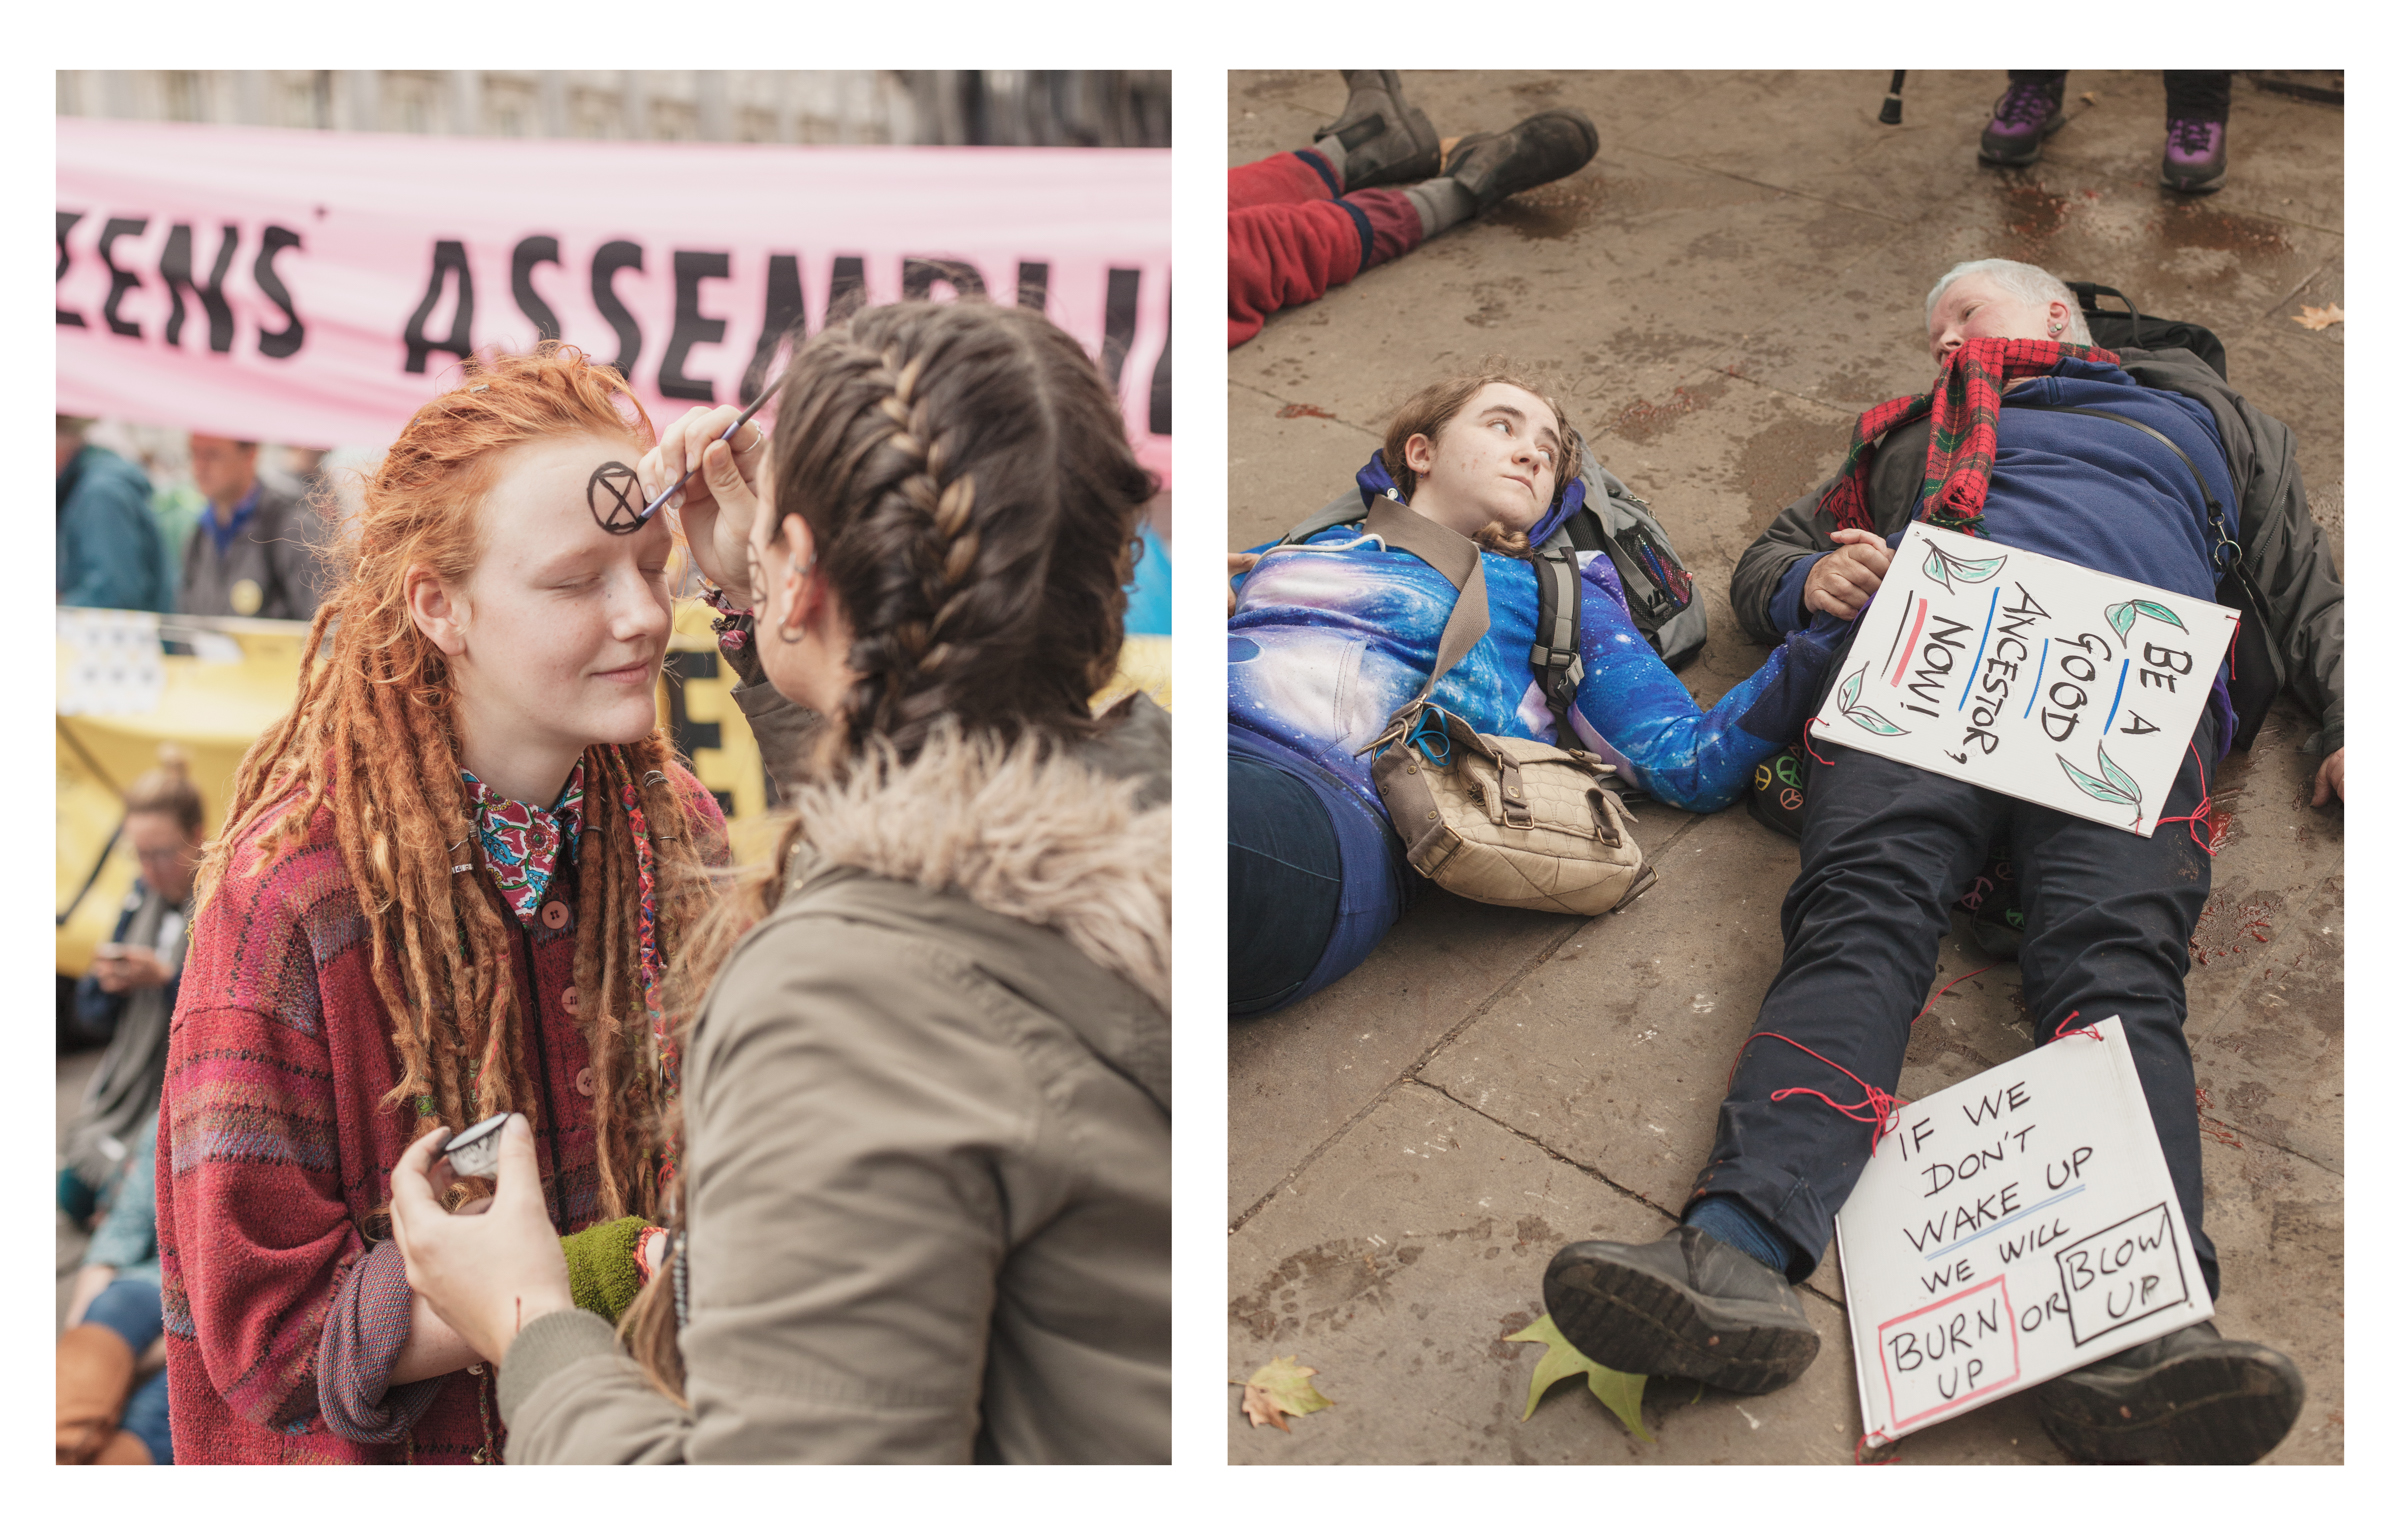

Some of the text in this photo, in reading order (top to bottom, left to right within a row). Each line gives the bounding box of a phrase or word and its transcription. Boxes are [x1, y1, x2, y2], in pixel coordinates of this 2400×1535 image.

[1900, 615, 1974, 720] NOW!
[1943, 581, 2052, 766] ANCESTOR,
[2041, 632, 2112, 743] GOOD
[2120, 641, 2193, 735] BE A
[1898, 1081, 2031, 1161] IF WE
[1921, 1124, 2036, 1198] DON'T
[1903, 1146, 2093, 1253] WAKE UP
[1921, 1218, 2070, 1294] WE WILL
[2066, 1211, 2168, 1292] BLOW
[1888, 1298, 1999, 1373] BURN
[2021, 1292, 2069, 1332] OR
[2107, 1274, 2160, 1319] UP
[1938, 1358, 1984, 1400] UP
